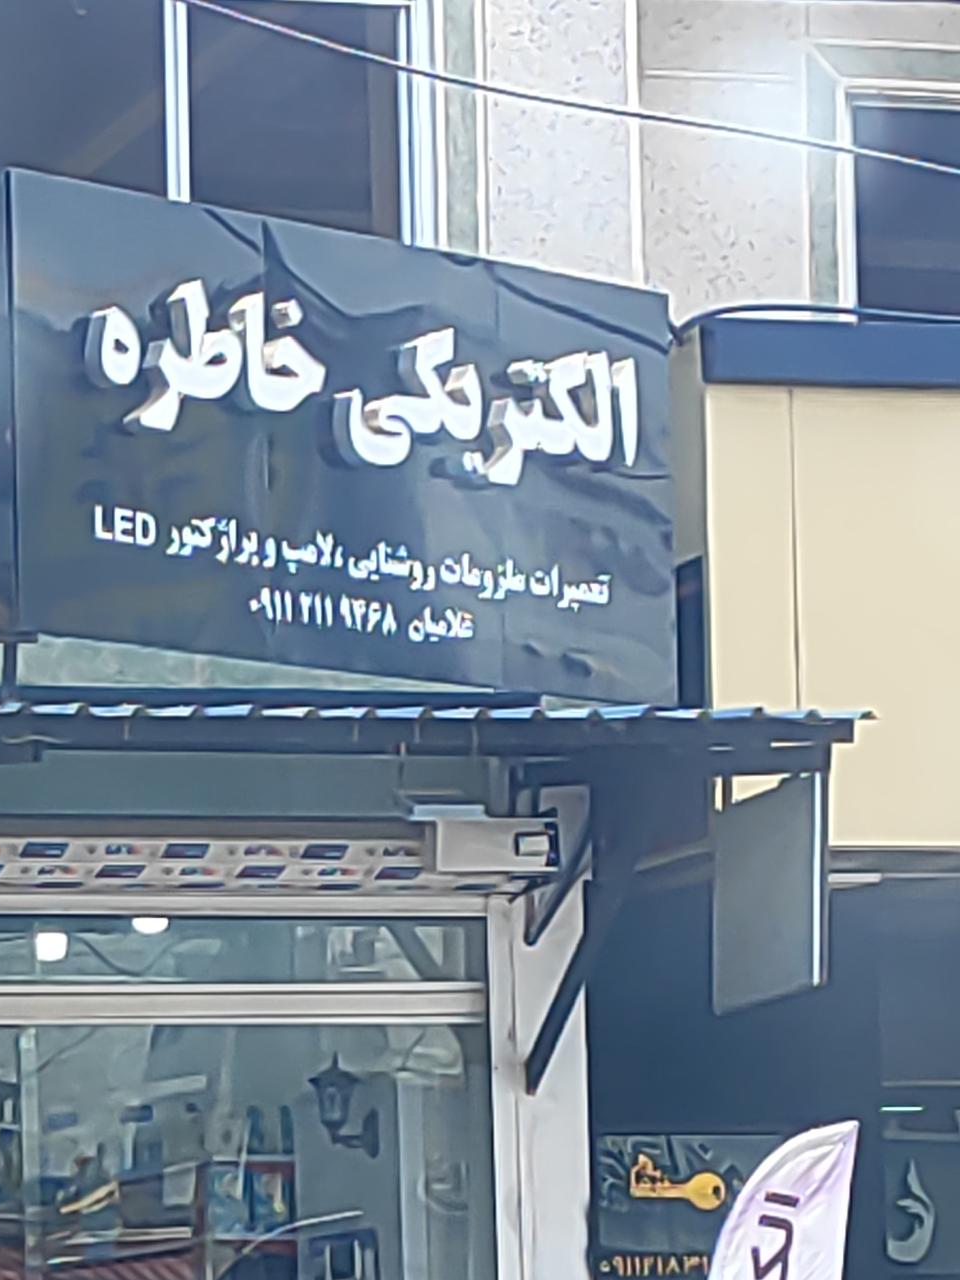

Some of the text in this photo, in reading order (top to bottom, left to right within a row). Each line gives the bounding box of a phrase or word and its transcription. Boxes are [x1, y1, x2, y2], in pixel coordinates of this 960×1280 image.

[86, 278, 640, 487] الکتریکی خاطره
[93, 503, 157, 547] LED
[262, 535, 277, 569] و
[439, 552, 528, 601] ملزومات
[528, 571, 613, 613] تعمیرات
[248, 586, 475, 643] غلامیان ۰۹۱۱ ۲۱۱ ۹۴۶۸
